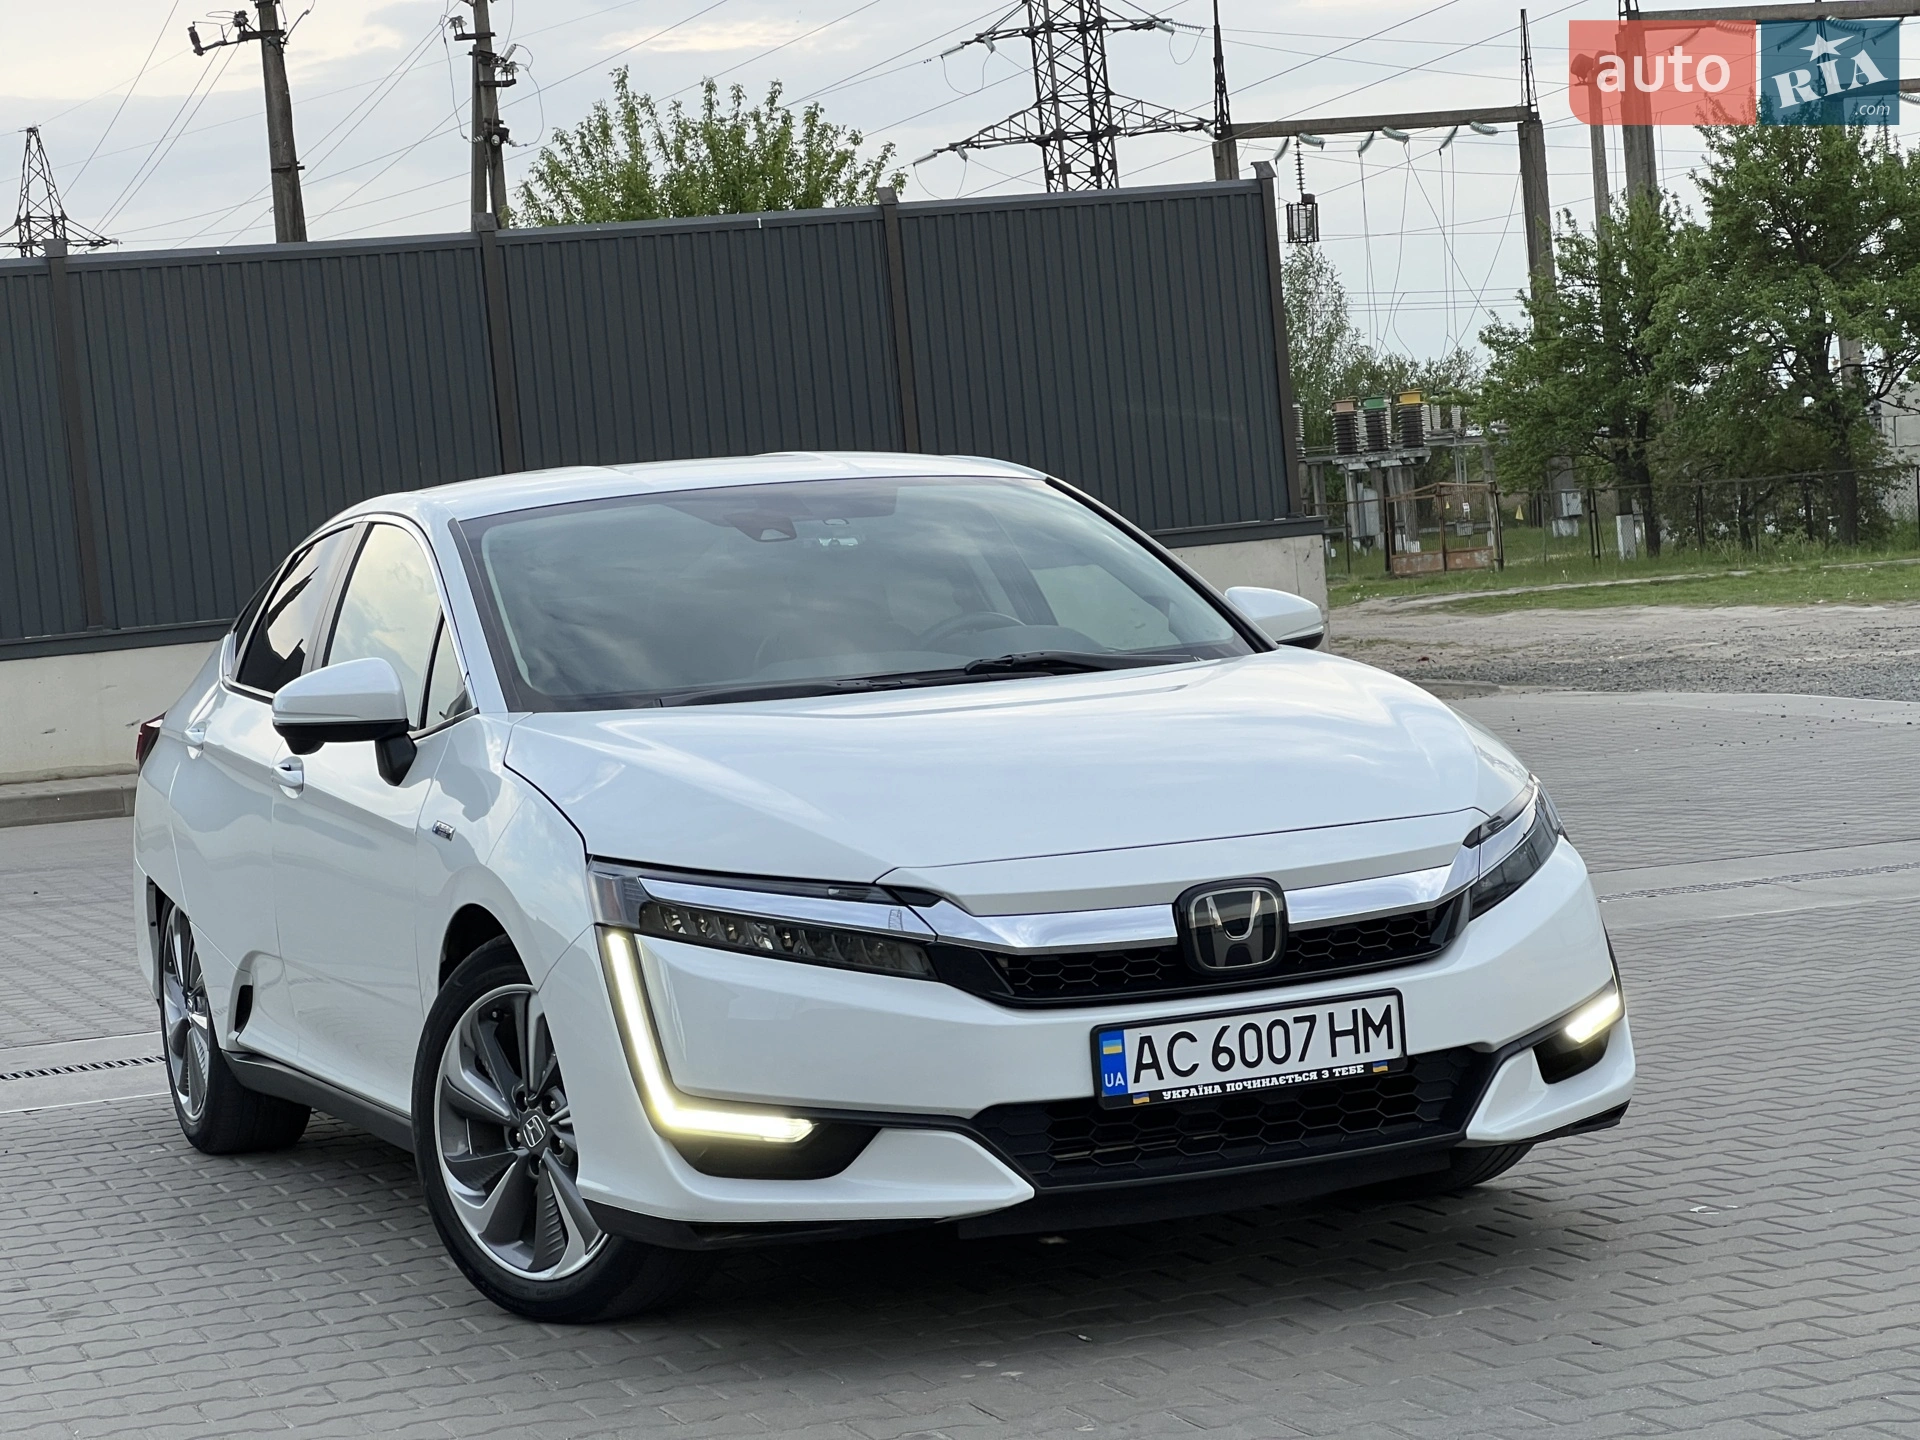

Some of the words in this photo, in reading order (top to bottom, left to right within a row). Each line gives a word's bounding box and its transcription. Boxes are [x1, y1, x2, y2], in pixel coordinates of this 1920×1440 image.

[1133, 1030, 1200, 1084] AC
[1211, 1013, 1317, 1072] 6007
[1328, 1004, 1394, 1058] HM
[1104, 1071, 1125, 1088] UA
[1162, 1084, 1222, 1100] УКРАЇНА
[1226, 1071, 1318, 1092] ПОЧИНАЄТЬСЯ
[1332, 1064, 1365, 1077] ТЕБЕ
